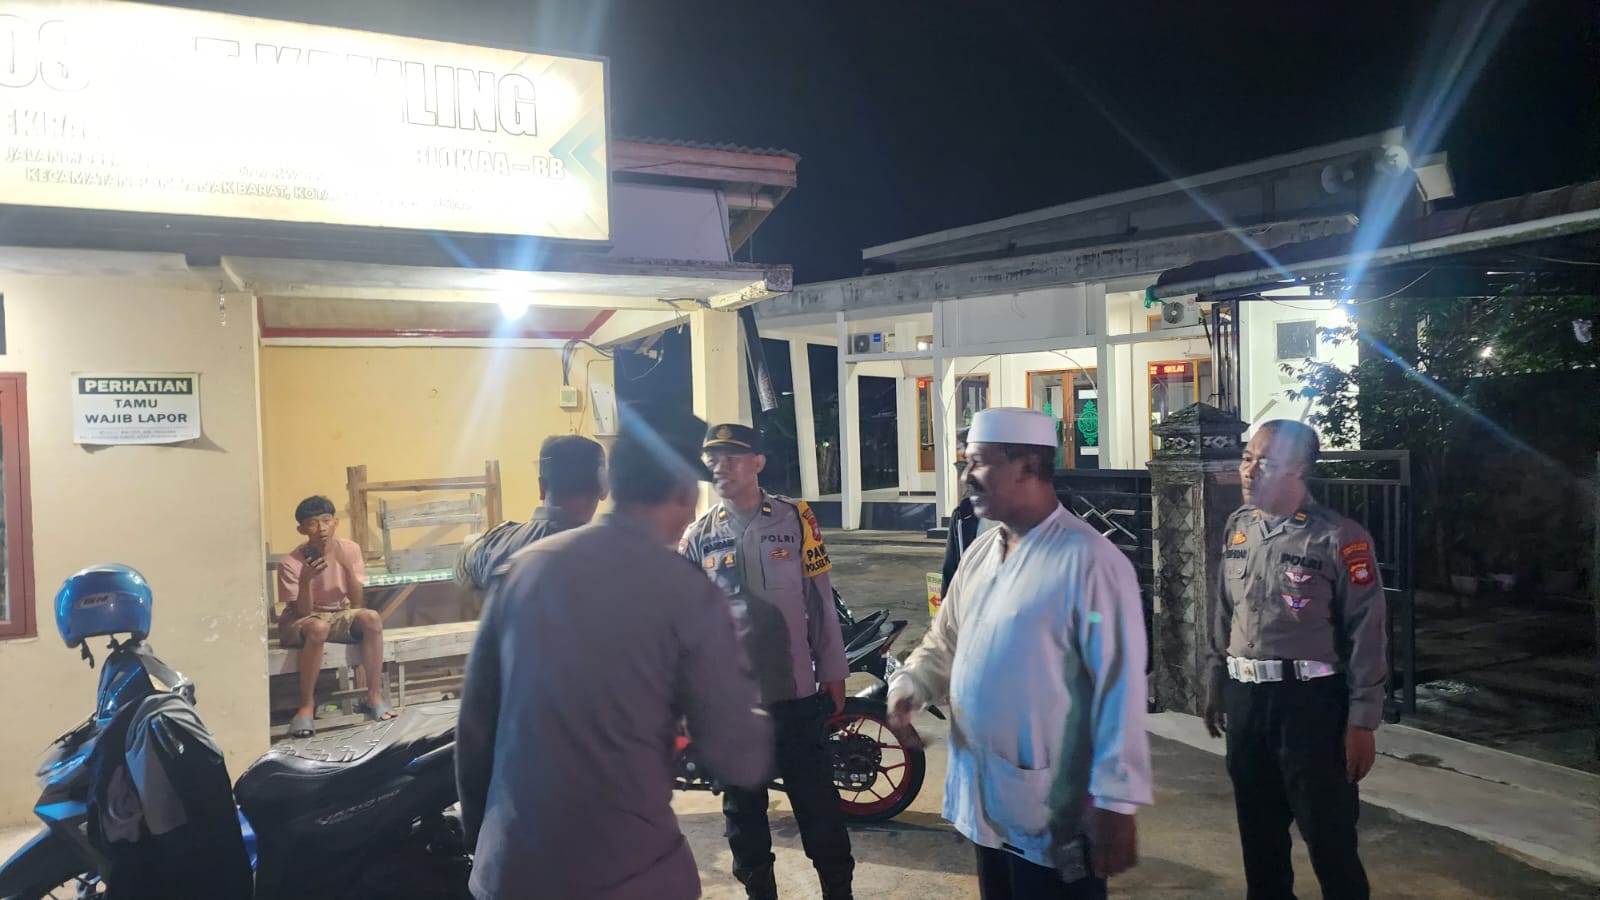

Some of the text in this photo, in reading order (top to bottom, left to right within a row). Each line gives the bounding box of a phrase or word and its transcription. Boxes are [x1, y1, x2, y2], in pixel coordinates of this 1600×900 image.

[85, 380, 188, 393] PERHATIAN
[114, 399, 158, 408] TAMU
[85, 413, 188, 423] WAJIB LAPOR
[760, 534, 795, 543] POLRI
[1280, 553, 1323, 570] POLRI
